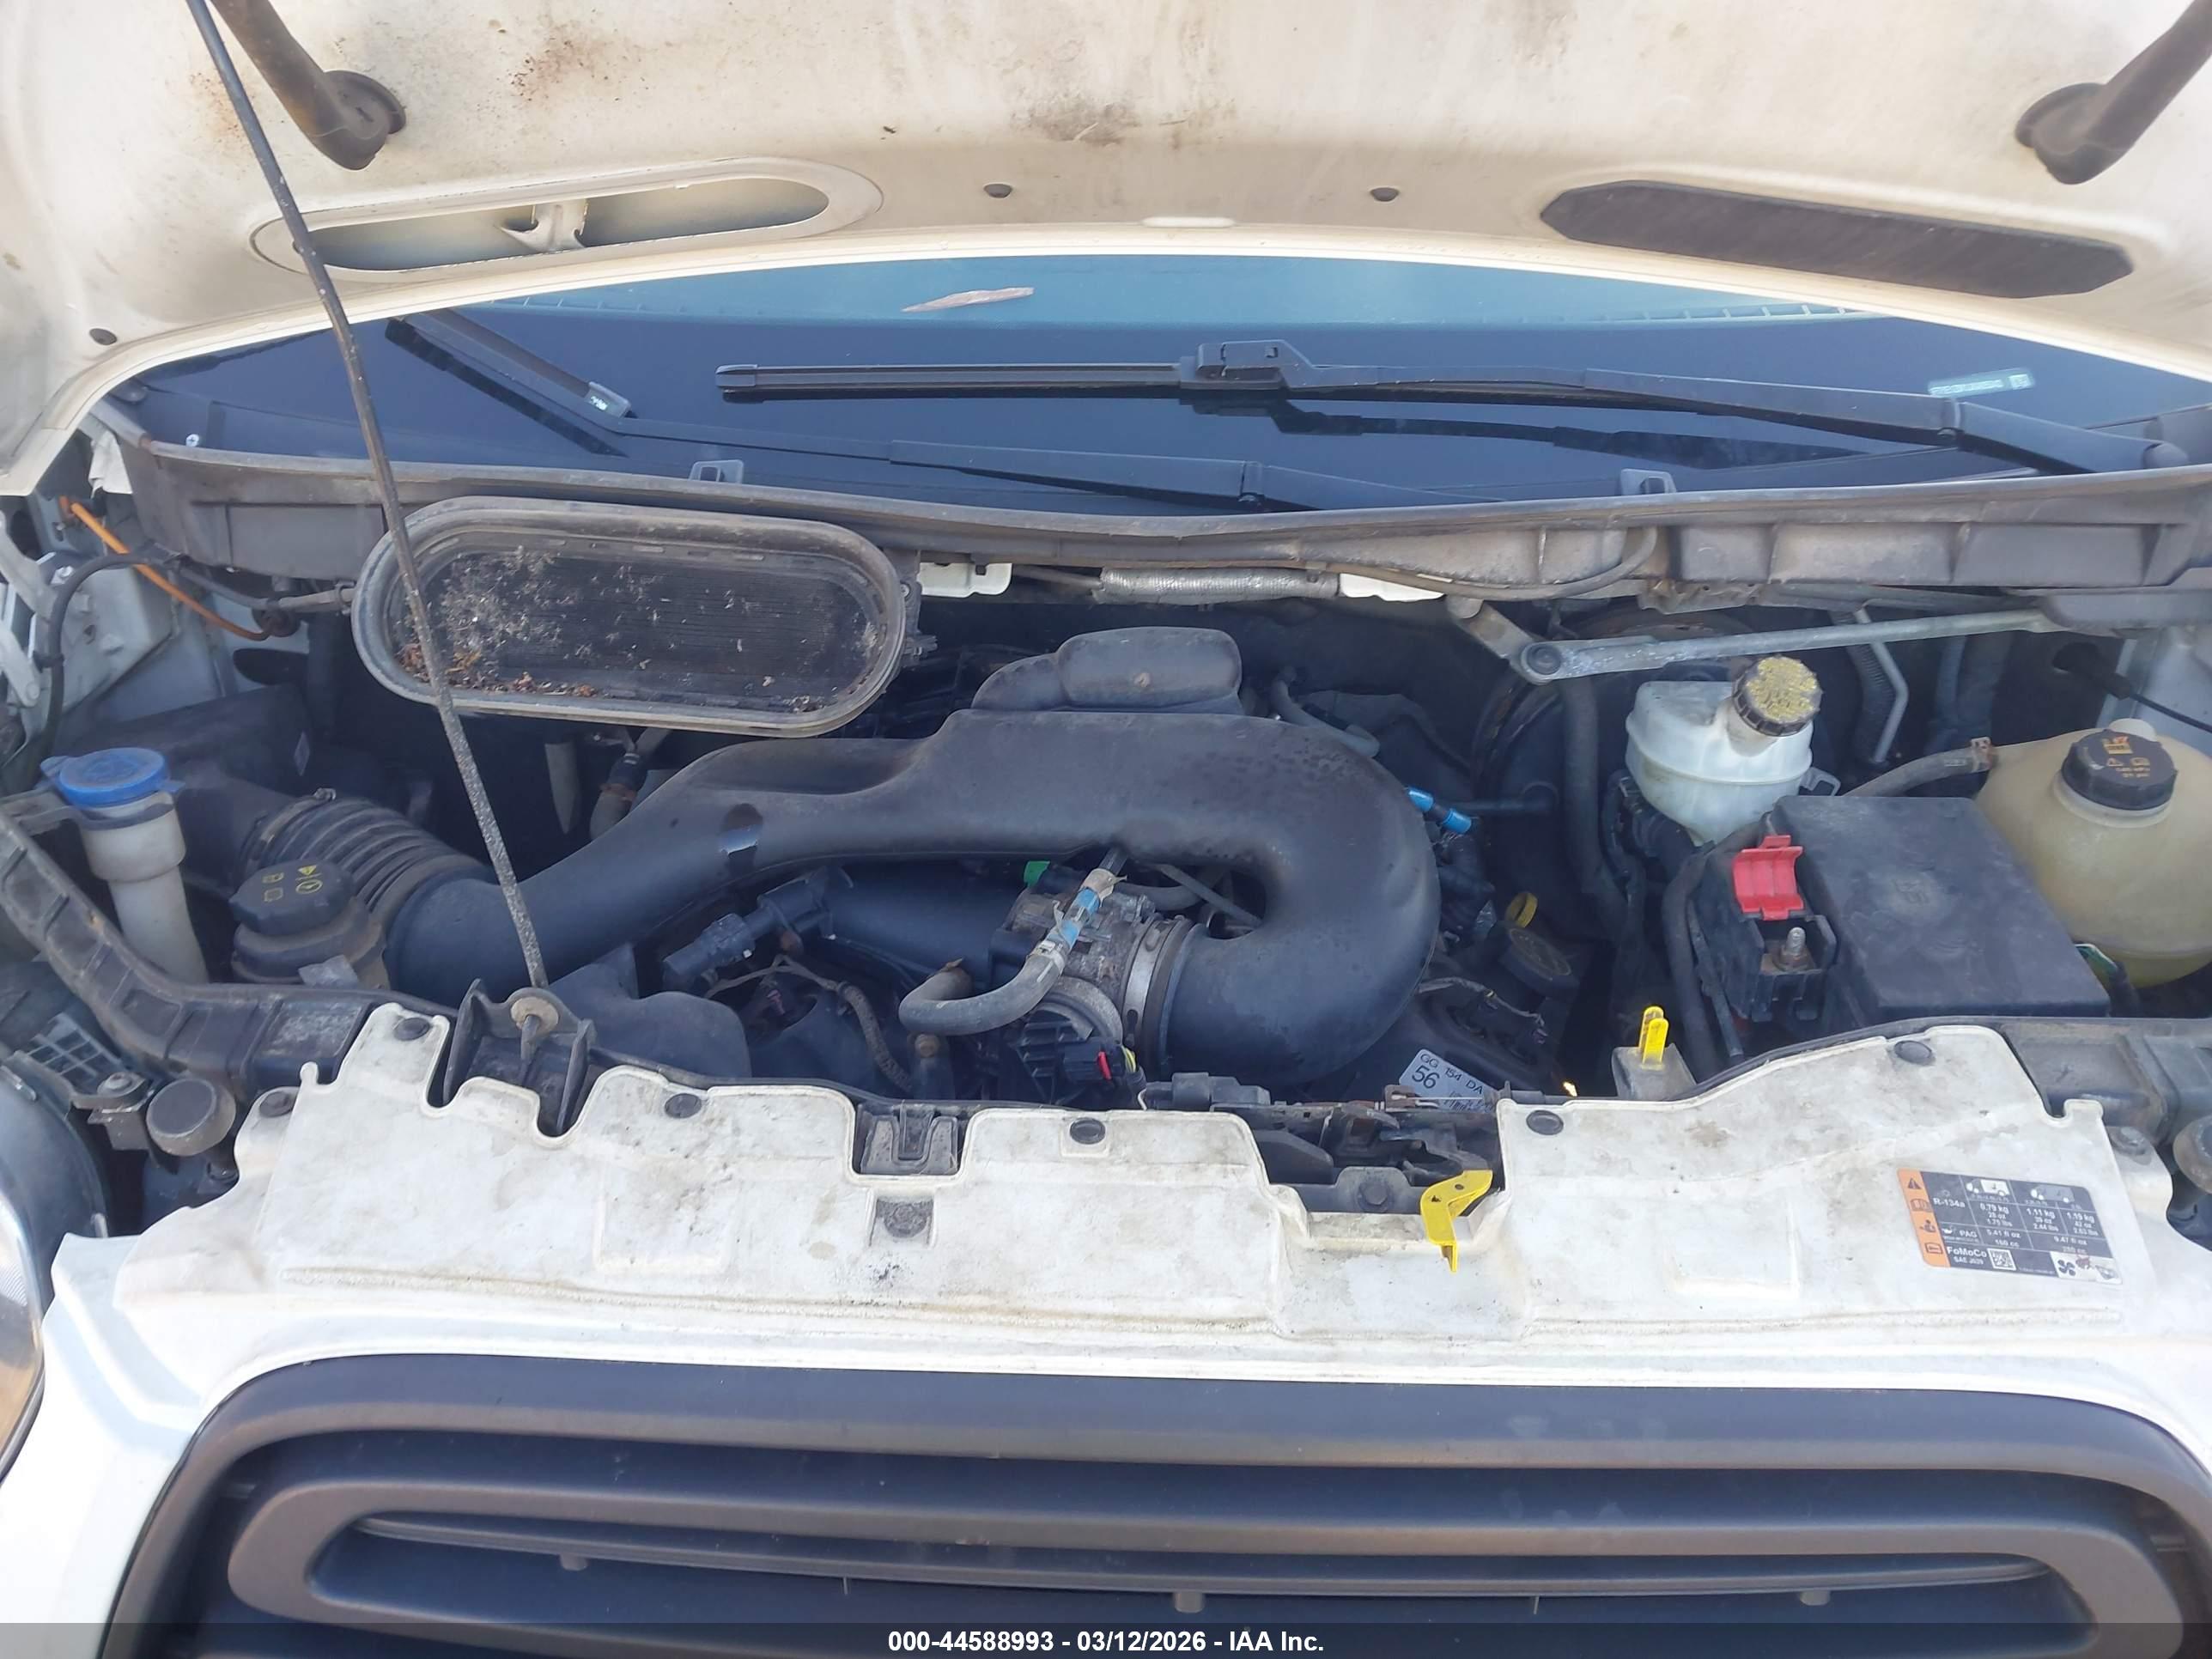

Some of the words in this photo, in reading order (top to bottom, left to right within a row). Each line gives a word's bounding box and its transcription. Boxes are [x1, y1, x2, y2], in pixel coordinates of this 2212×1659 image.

[1411, 1065, 1440, 1089] 56
[1420, 1054, 1440, 1067] GG
[1466, 1079, 1484, 1095] DA
[1933, 1197, 1966, 1208] R-134a
[1997, 1205, 2009, 1214] kg
[2045, 1209, 2056, 1218] kg
[2084, 1214, 2095, 1223] kg
[1946, 1246, 1987, 1257] FoMoCo
